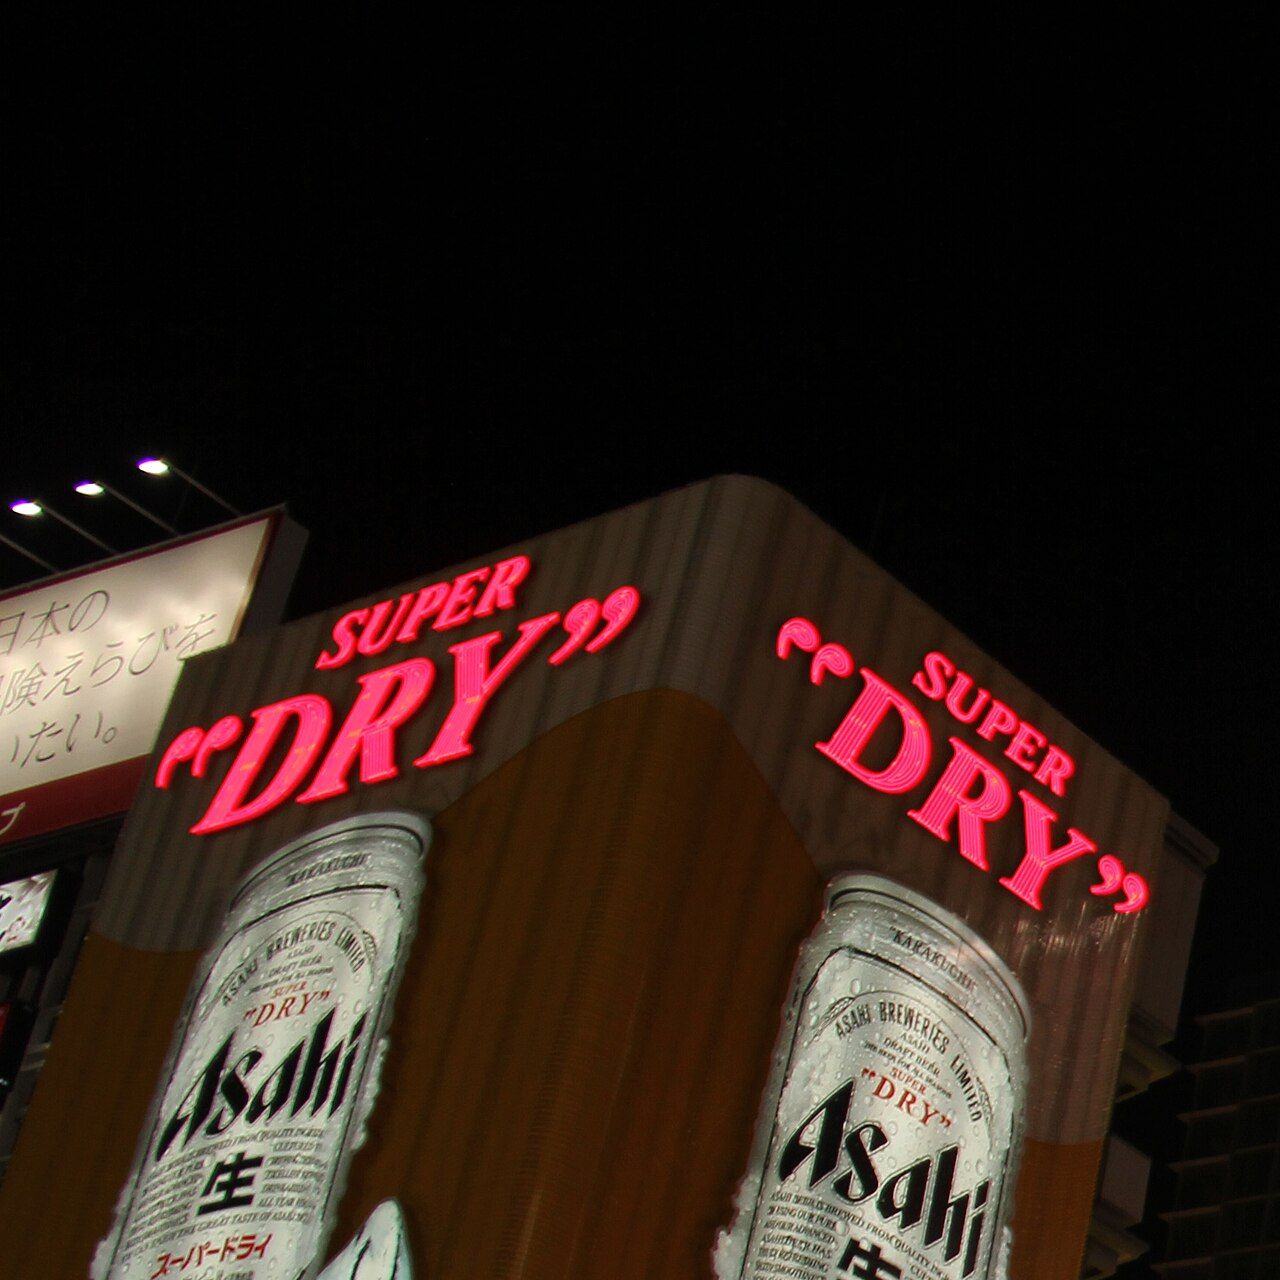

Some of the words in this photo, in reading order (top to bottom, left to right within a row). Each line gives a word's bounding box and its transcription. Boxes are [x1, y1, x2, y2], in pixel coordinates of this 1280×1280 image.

[315, 554, 531, 669] SUPER
[912, 650, 1076, 798] SUPER
[265, 920, 337, 960] BREWERIES
[334, 929, 365, 972] LIMITED
[157, 1007, 369, 1161] Asahi
[834, 1002, 871, 1038] ASAHI
[879, 1001, 950, 1055] BREWERIES
[950, 1053, 983, 1123] LIMITED
[889, 1067, 927, 1095] SUPER
[196, 1152, 264, 1216] 生
[779, 1077, 991, 1279] Asahi
[150, 1234, 273, 1280] スーパードライ
